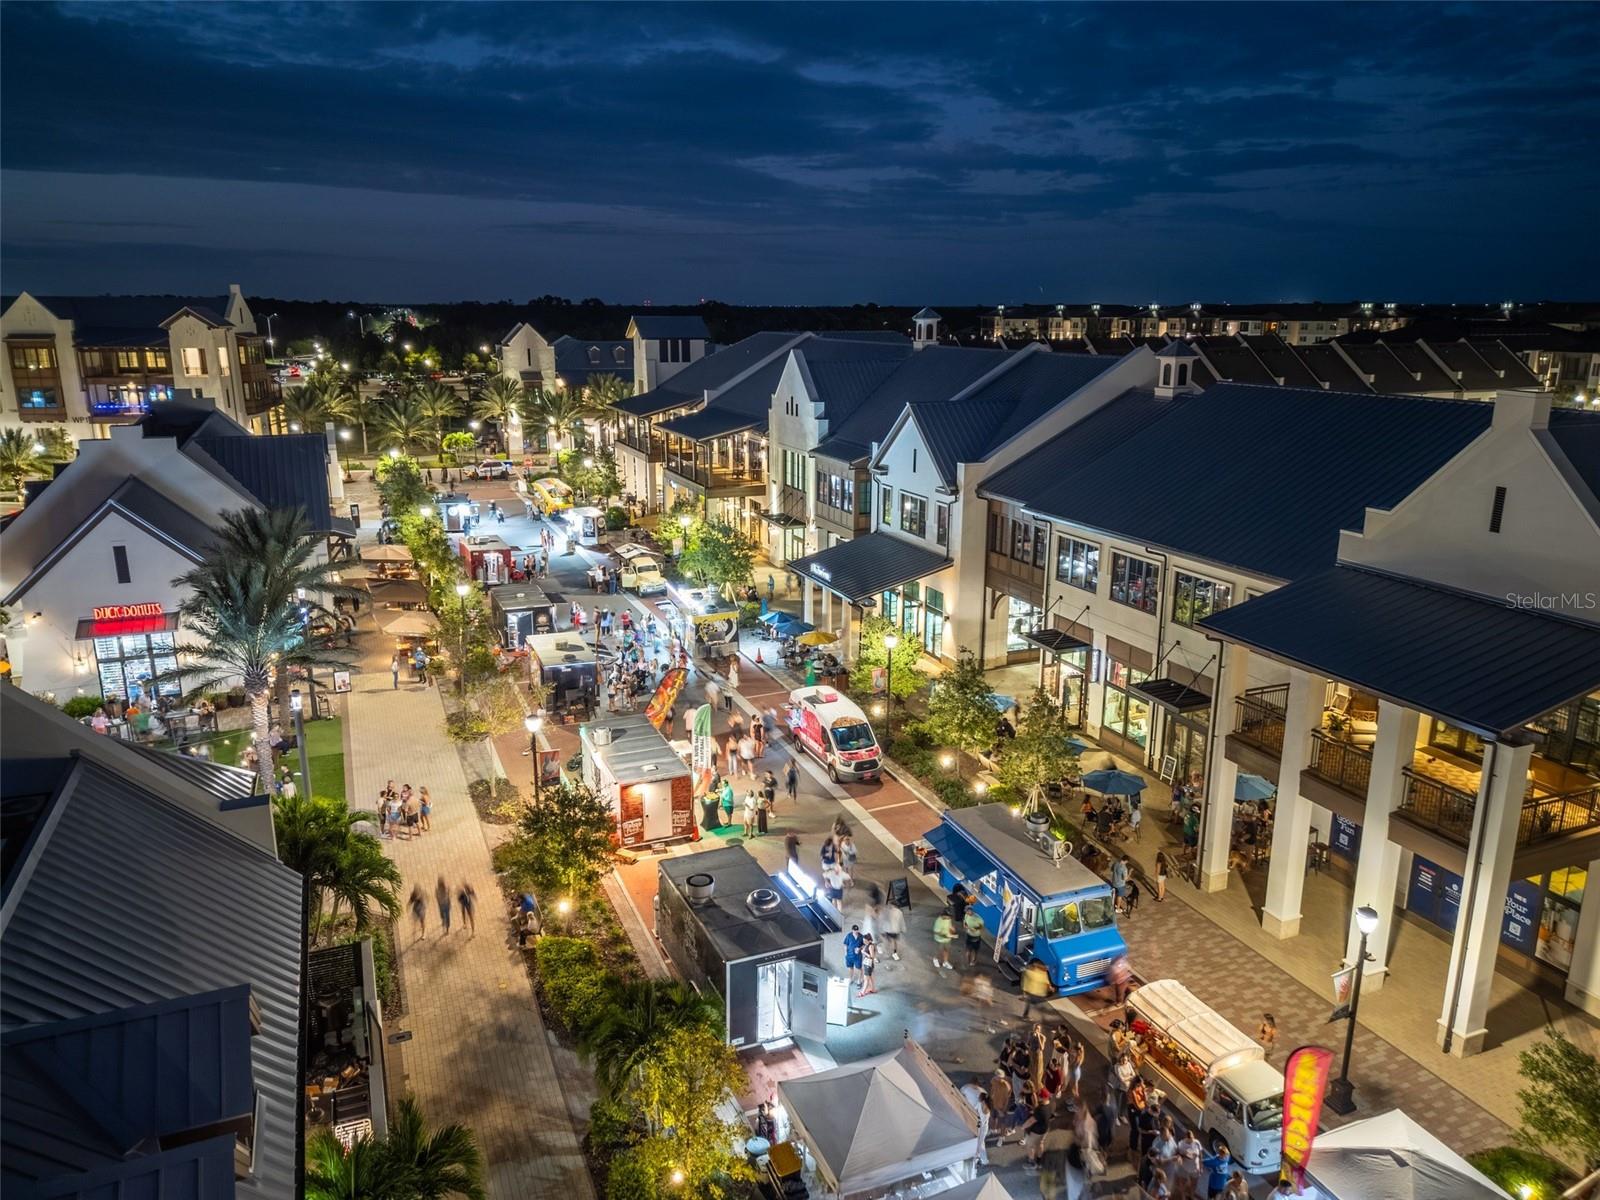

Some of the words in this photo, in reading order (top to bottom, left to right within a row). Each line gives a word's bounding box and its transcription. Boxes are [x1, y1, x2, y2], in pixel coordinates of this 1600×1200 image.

[93, 606, 121, 620] DUCK
[123, 603, 162, 617] DONUTS
[1505, 896, 1528, 914] Your
[1504, 905, 1532, 926] Place
